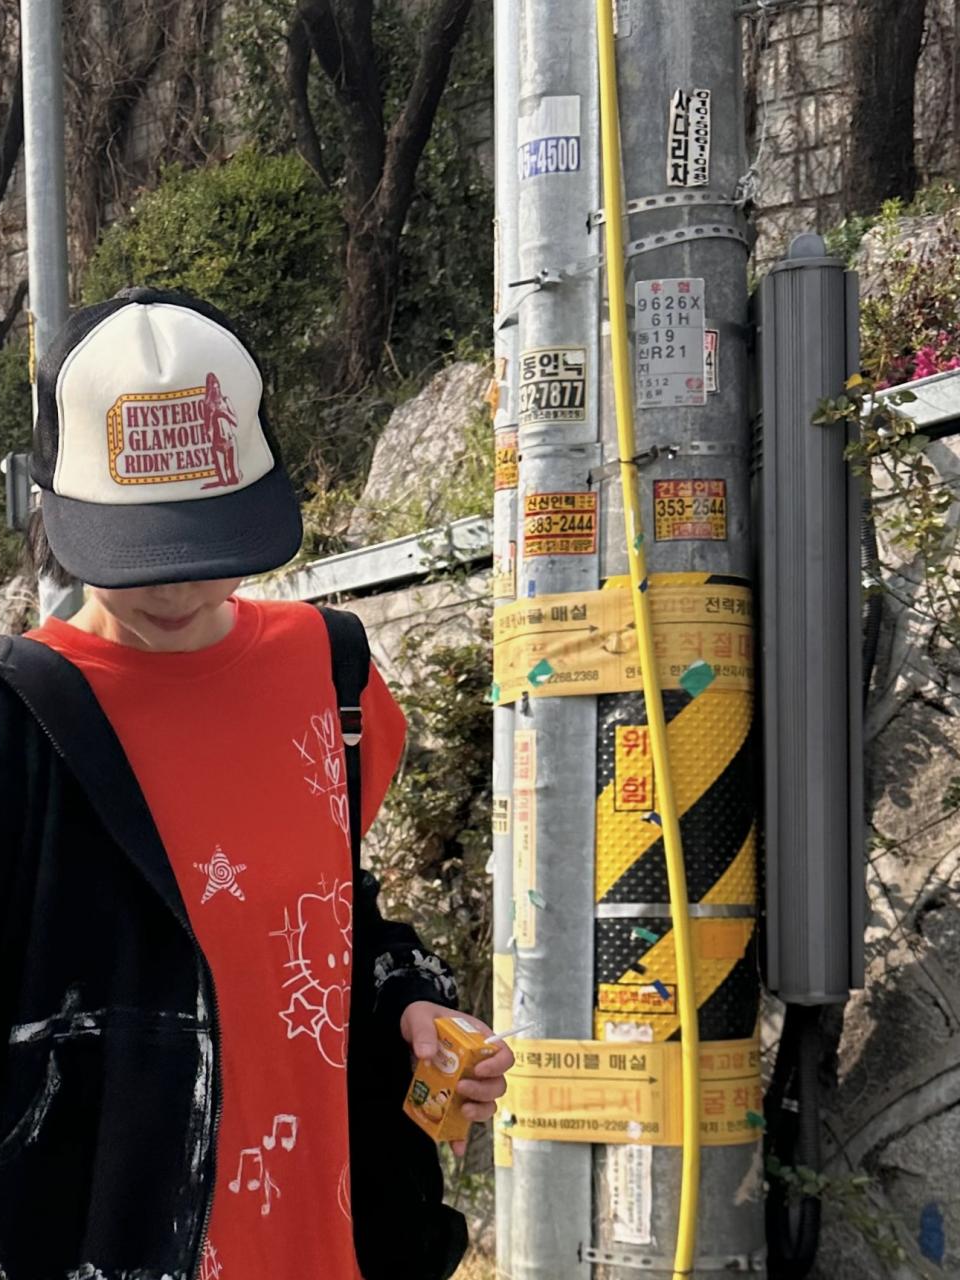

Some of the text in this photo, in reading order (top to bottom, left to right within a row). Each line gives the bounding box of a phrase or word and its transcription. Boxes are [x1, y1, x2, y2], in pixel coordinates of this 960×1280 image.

[669, 89, 690, 186] 사다리차
[129, 423, 212, 452] GLAMOUR
[657, 498, 724, 517] 353-2544
[551, 604, 586, 622] 매설
[609, 1054, 646, 1071] 매설
